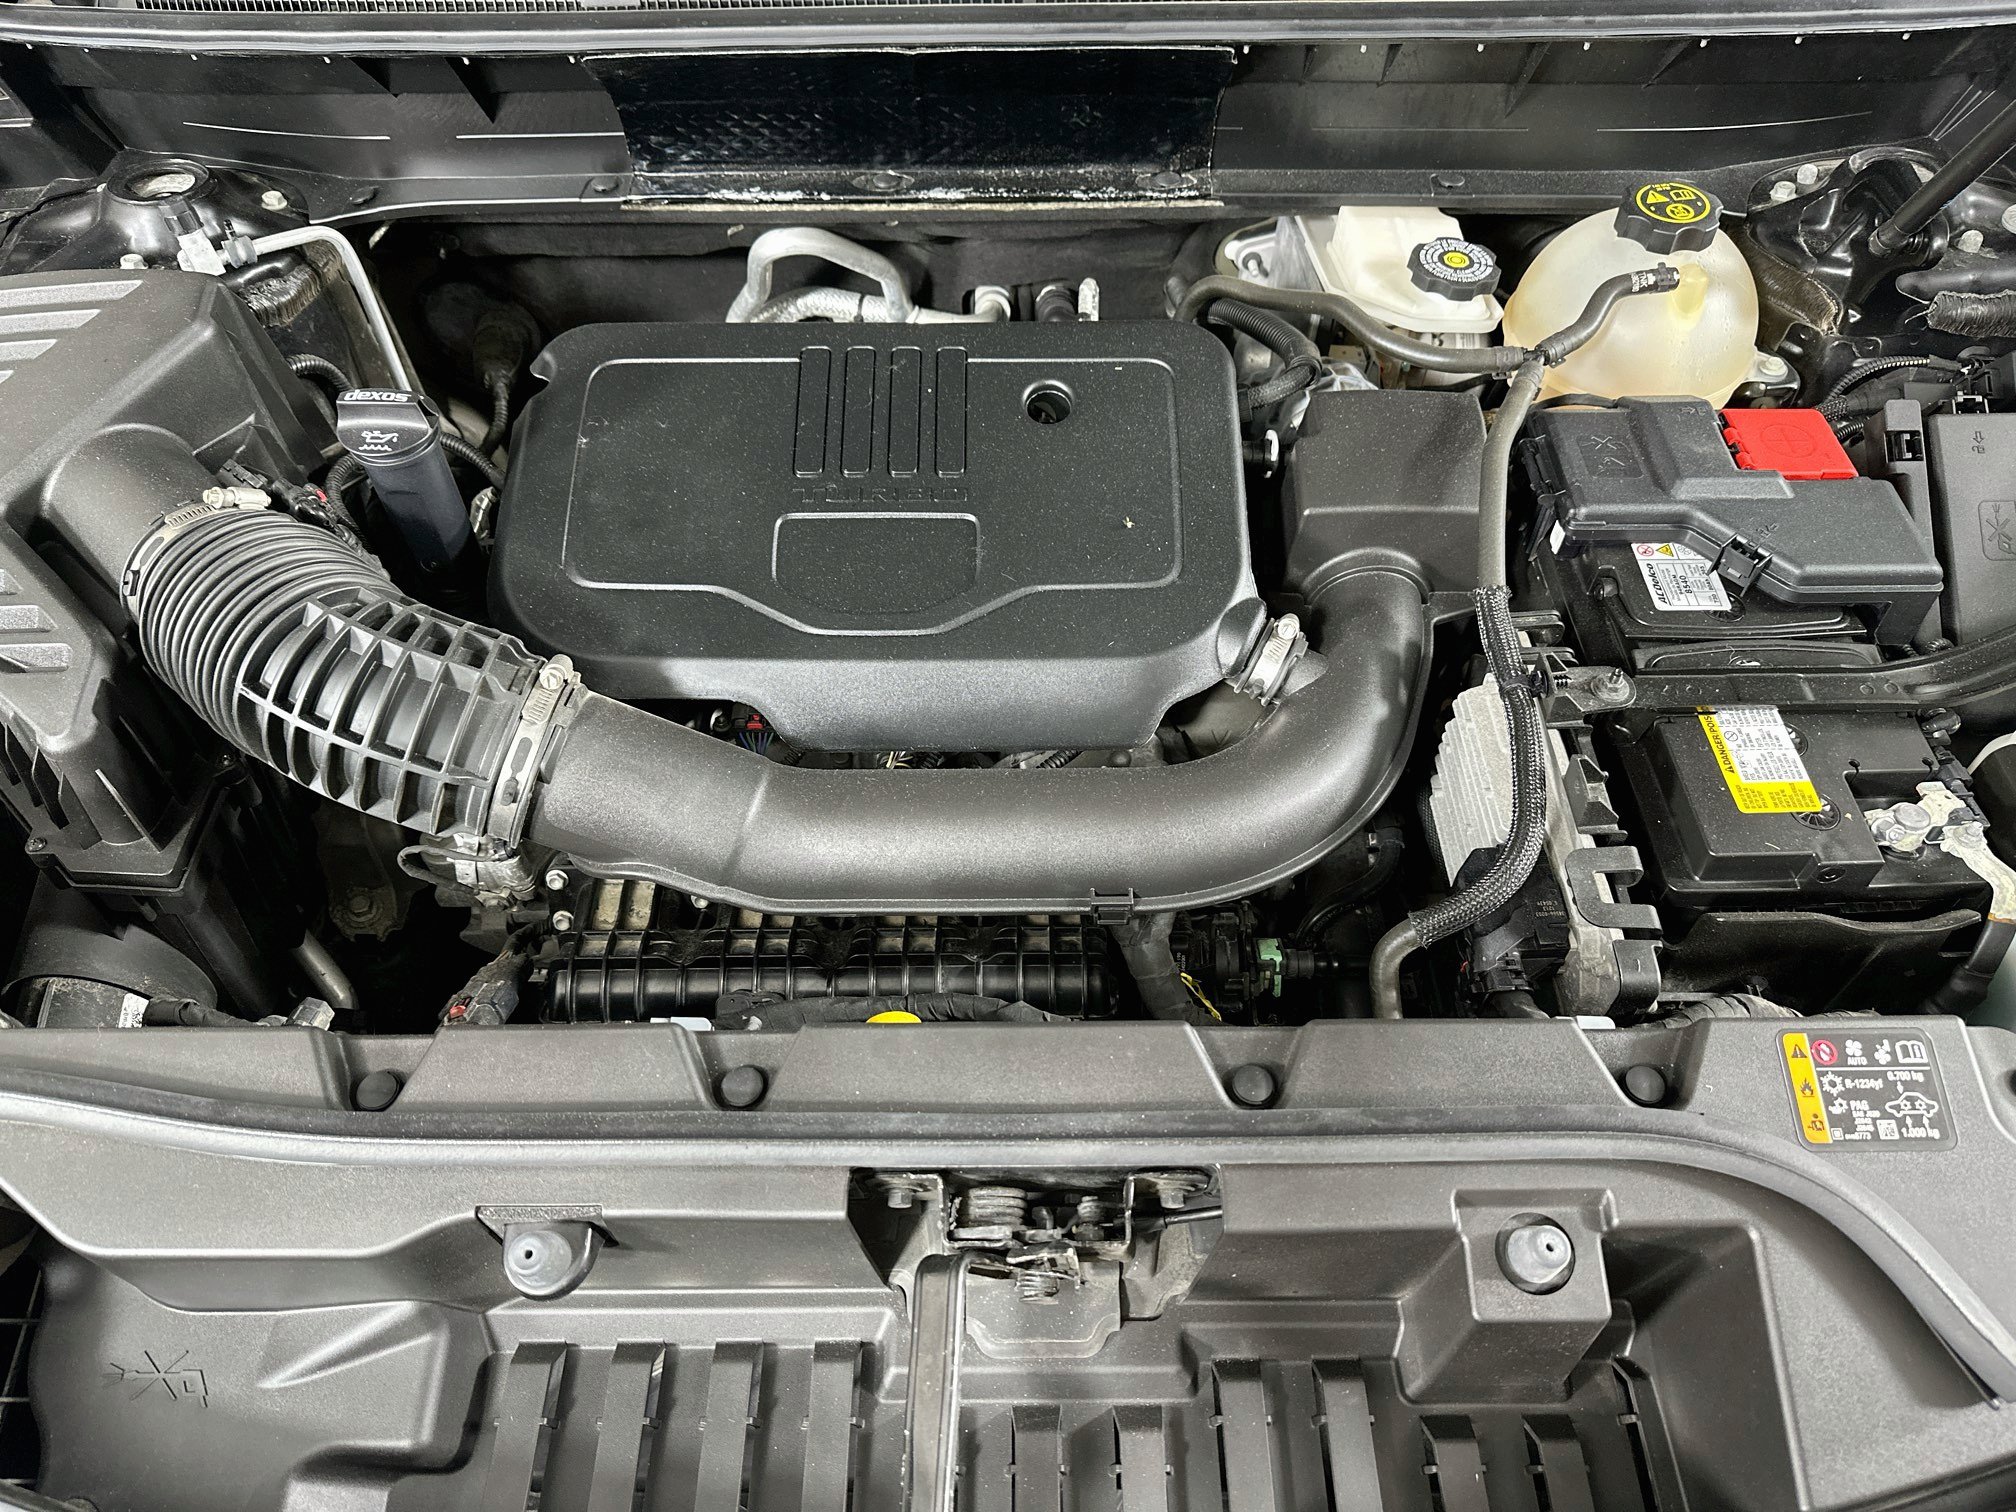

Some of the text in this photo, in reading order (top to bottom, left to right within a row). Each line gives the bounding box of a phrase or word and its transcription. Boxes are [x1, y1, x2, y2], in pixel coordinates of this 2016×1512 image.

[343, 389, 412, 402] dexos
[792, 487, 968, 503] TURBO
[1646, 563, 1668, 604] ACDelco
[1679, 575, 1693, 594] 8540
[1847, 1056, 1868, 1066] AUTO
[1911, 1070, 1925, 1083] kg
[1901, 1126, 1940, 1140] 1.000 kg
